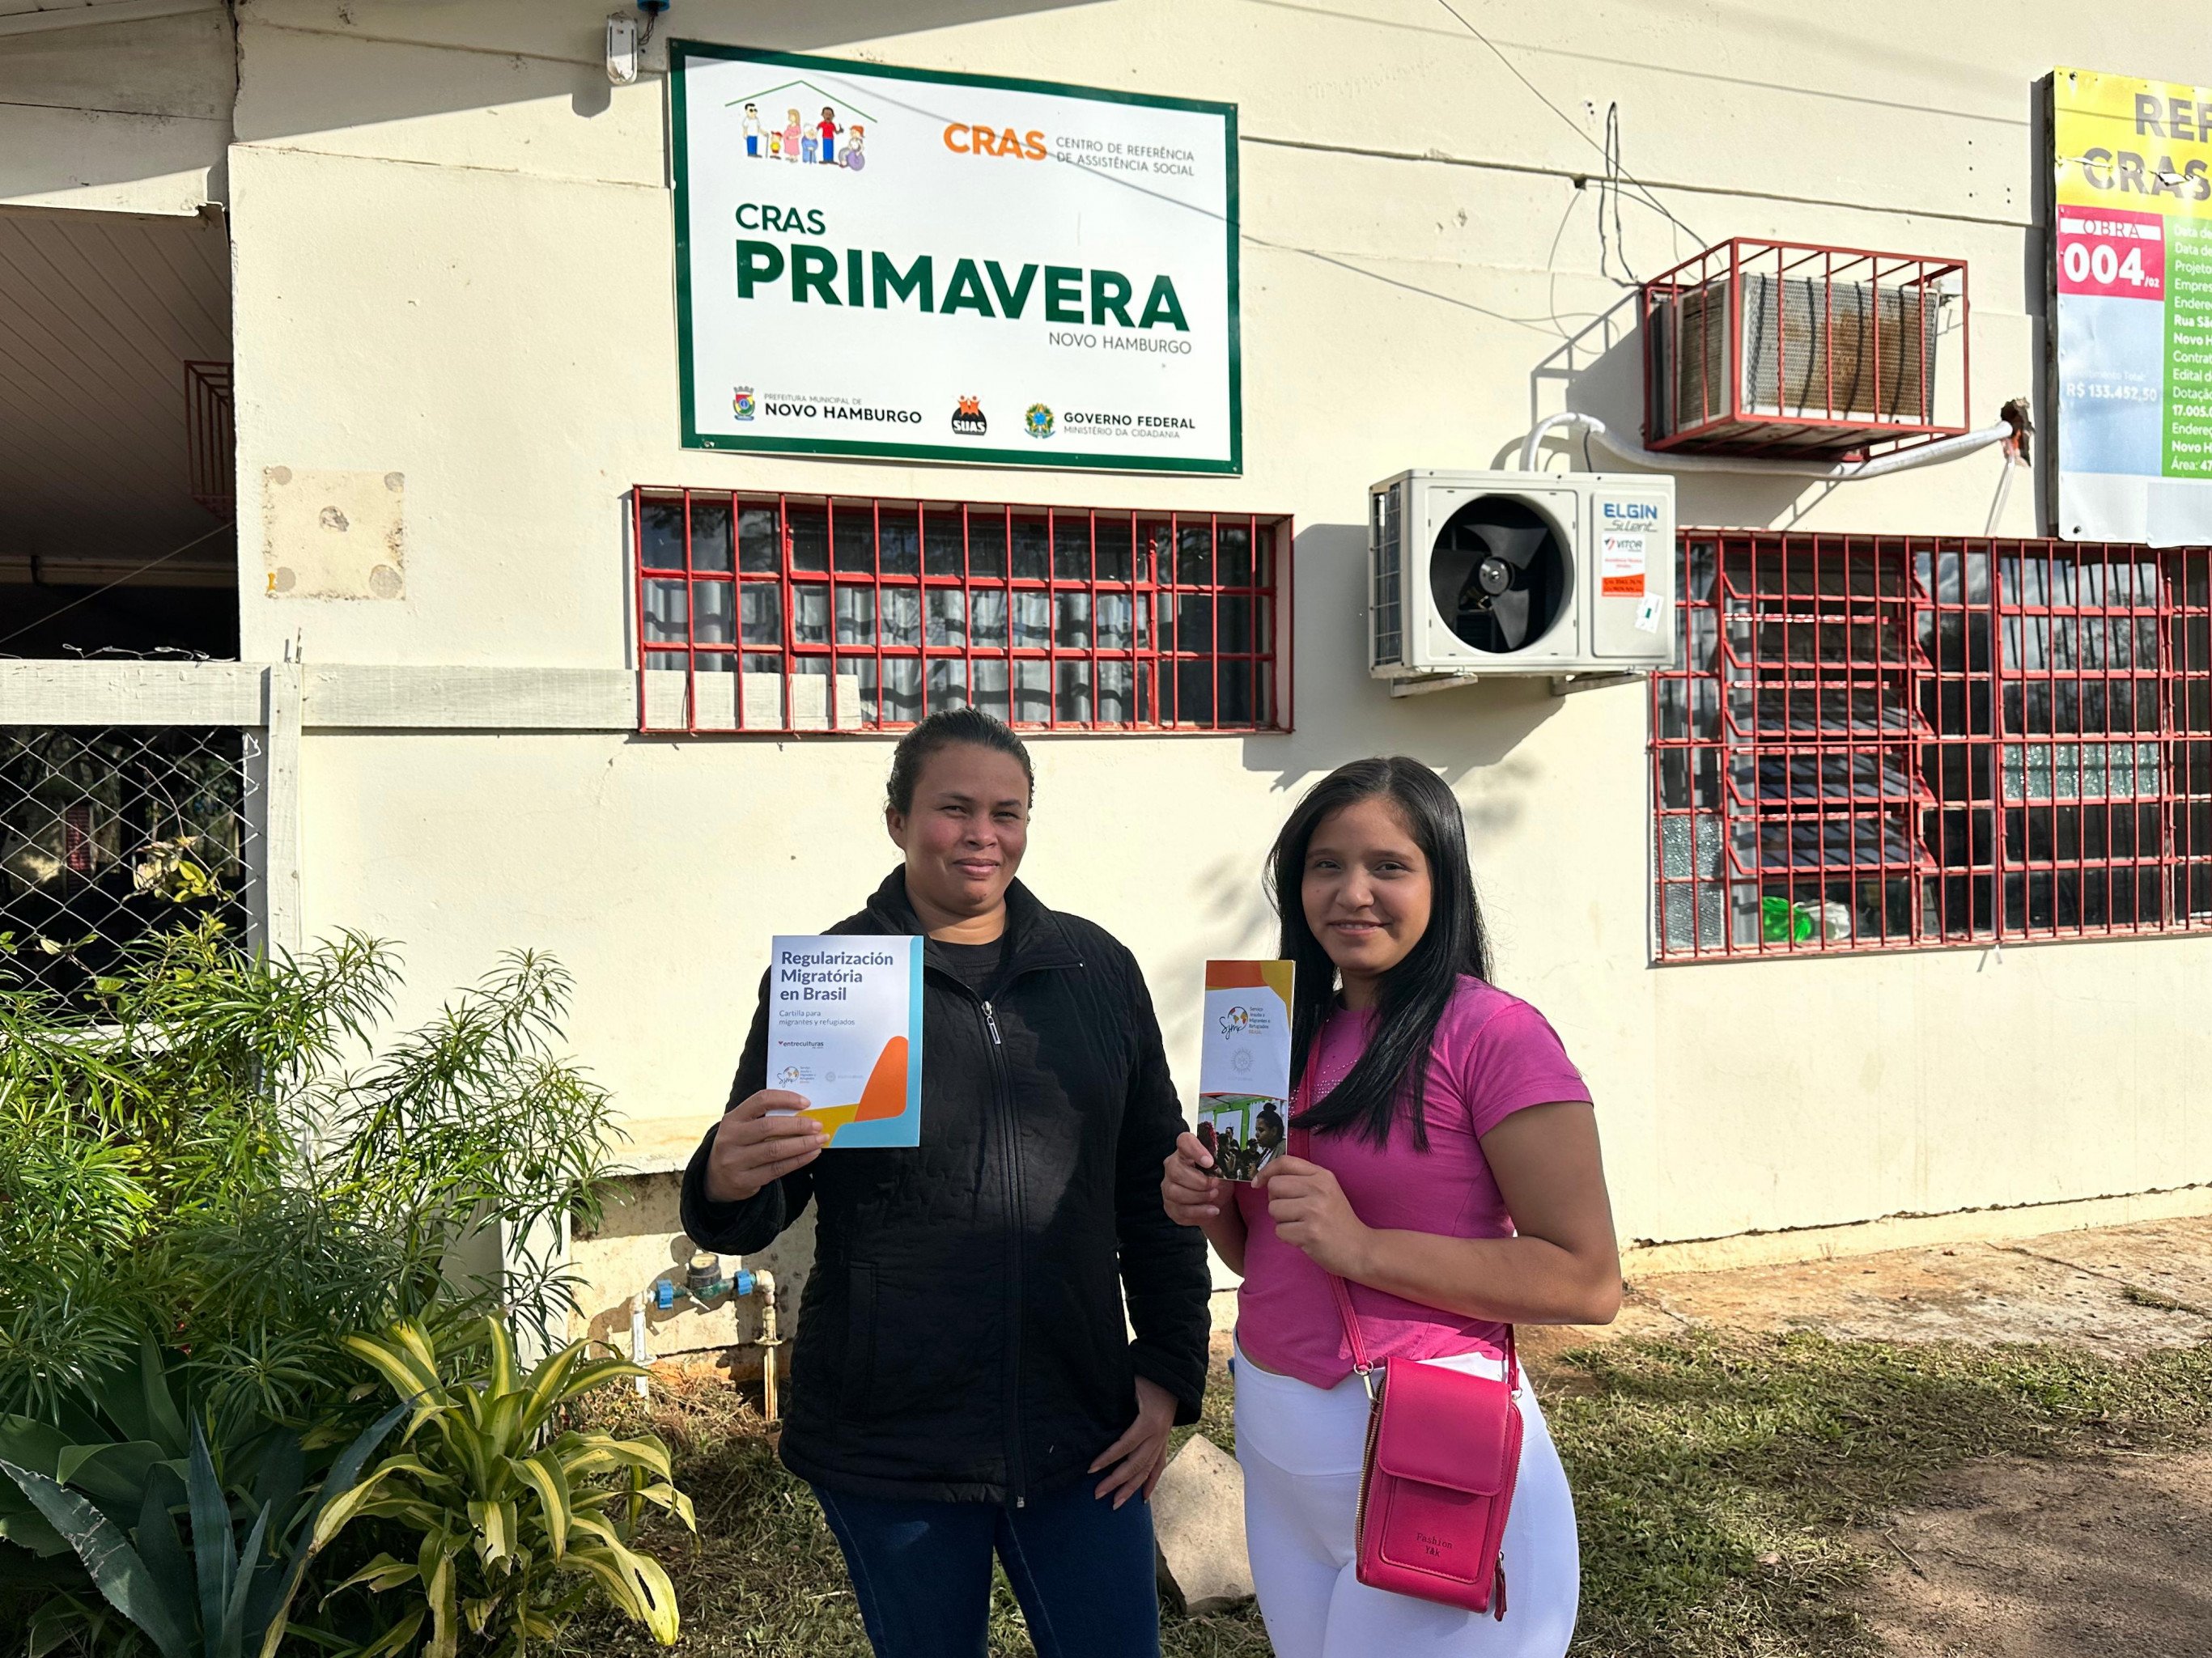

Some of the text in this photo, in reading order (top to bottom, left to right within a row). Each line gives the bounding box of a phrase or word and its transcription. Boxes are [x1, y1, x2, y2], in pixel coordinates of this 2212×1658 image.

[944, 122, 1047, 161] CRAS
[1055, 136, 1195, 162] CENTRO DE REFERÊNCIA
[1056, 151, 1195, 176] DE ASSISTÊNCIA SOCIAL
[2083, 147, 2211, 201] CRAS
[735, 203, 826, 235] CRAS
[2083, 218, 2140, 239] OBRA
[2174, 224, 2198, 237] Data
[2175, 242, 2199, 255] Data
[2175, 260, 2212, 276] Projeto
[736, 239, 1191, 333] PRIMAVERA
[2174, 295, 2212, 310] Endere
[2174, 314, 2195, 327] Rua
[1049, 332, 1192, 354] NOVO HAMBURGO
[2173, 332, 2203, 346] Novo
[2173, 367, 2202, 382] Edital
[2066, 381, 2086, 398] R$
[764, 392, 863, 405] PREFEITURA MUNICIPAL DE
[765, 402, 922, 423] NOVO HAMBURGO
[1064, 412, 1196, 429] GOVERNO FEDERAL
[953, 419, 986, 433] SUAS
[1064, 426, 1181, 439] MINISTÉRIO DA CIDADANIA
[2172, 440, 2201, 452] Novo
[1603, 502, 1658, 519] ELGIN
[781, 951, 894, 967] Regularización
[781, 969, 863, 985] Migratória
[780, 987, 847, 1000] en Brasil
[1416, 1533, 1452, 1549] Fashion
